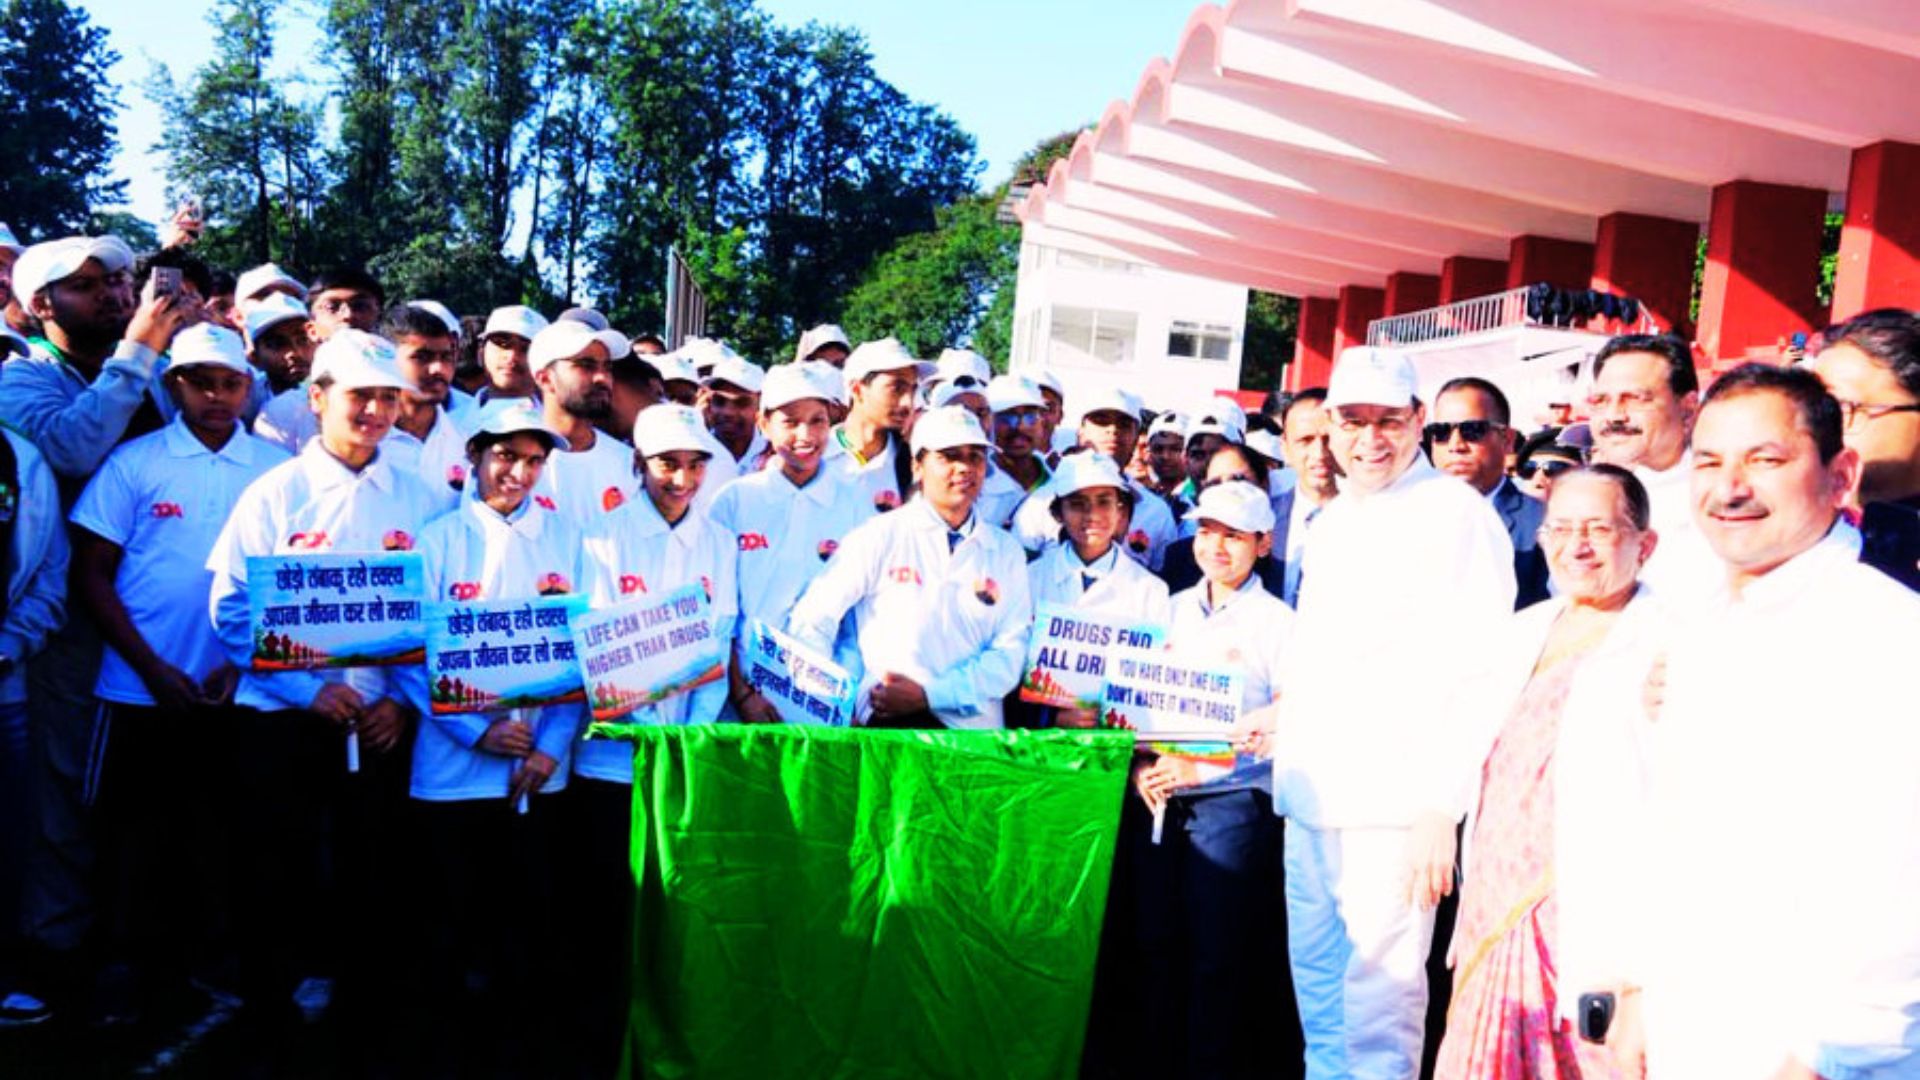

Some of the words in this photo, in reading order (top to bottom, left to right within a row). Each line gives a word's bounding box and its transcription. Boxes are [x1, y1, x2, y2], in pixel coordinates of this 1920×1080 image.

[347, 560, 368, 588] रहो
[369, 566, 404, 587] स्वस्थ
[262, 605, 300, 628] अपना
[303, 598, 340, 625] जीवन
[343, 602, 365, 623] कर
[367, 595, 384, 622] लो
[514, 603, 533, 630] रहो
[535, 606, 568, 628] स्वस्थ
[584, 621, 613, 648] LIFE
[614, 612, 640, 638] CAN
[641, 602, 672, 628] TAKE
[673, 595, 698, 617] YOU
[586, 645, 634, 677] HIGHER
[634, 634, 667, 660] THAN
[668, 618, 711, 649] DRUGS
[1048, 616, 1112, 647] DRUGS
[437, 650, 472, 672] अपना
[473, 641, 508, 668] जीवन
[510, 644, 532, 664] कर
[533, 636, 549, 663] लो
[1036, 646, 1069, 671] ALL
[1075, 652, 1106, 677] DR
[1120, 658, 1137, 678] YOU
[1139, 661, 1163, 684] HAVE
[1164, 665, 1188, 687] ONLY
[1190, 670, 1209, 691] ONE
[1209, 674, 1230, 696] LIFE
[1134, 689, 1166, 711] WASTE
[1167, 694, 1177, 712] IT
[1179, 697, 1202, 718] WITH
[1204, 700, 1237, 723] DRUGS
